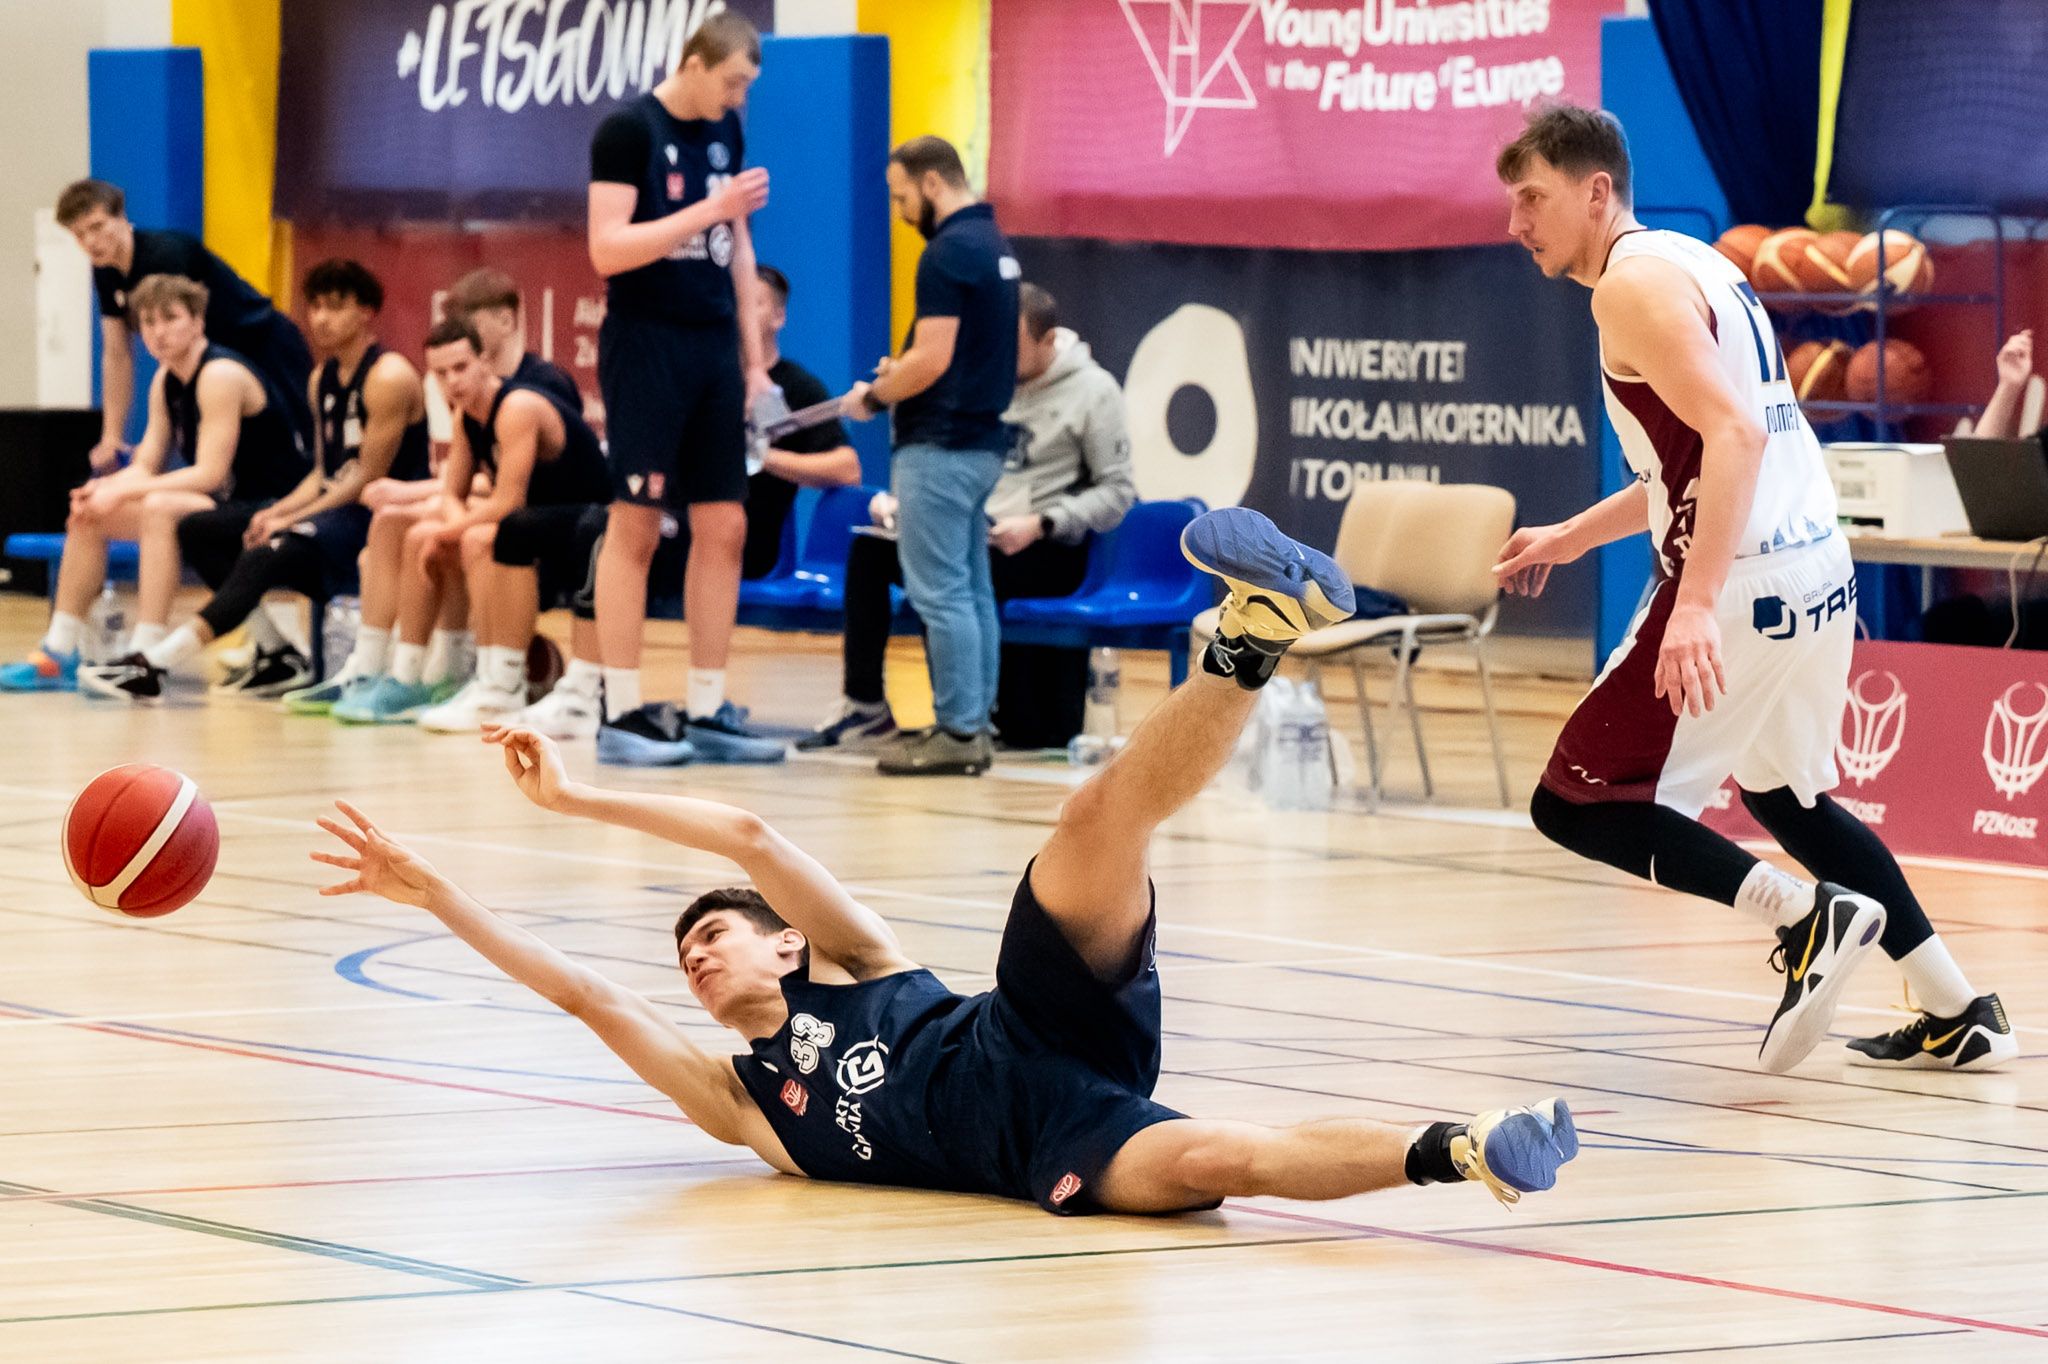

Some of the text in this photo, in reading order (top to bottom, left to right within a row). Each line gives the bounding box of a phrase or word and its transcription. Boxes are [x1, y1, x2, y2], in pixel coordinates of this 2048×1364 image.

[1259, 0, 1361, 57] Young
[1319, 60, 1437, 112] Future
[791, 1012, 836, 1075] 33
